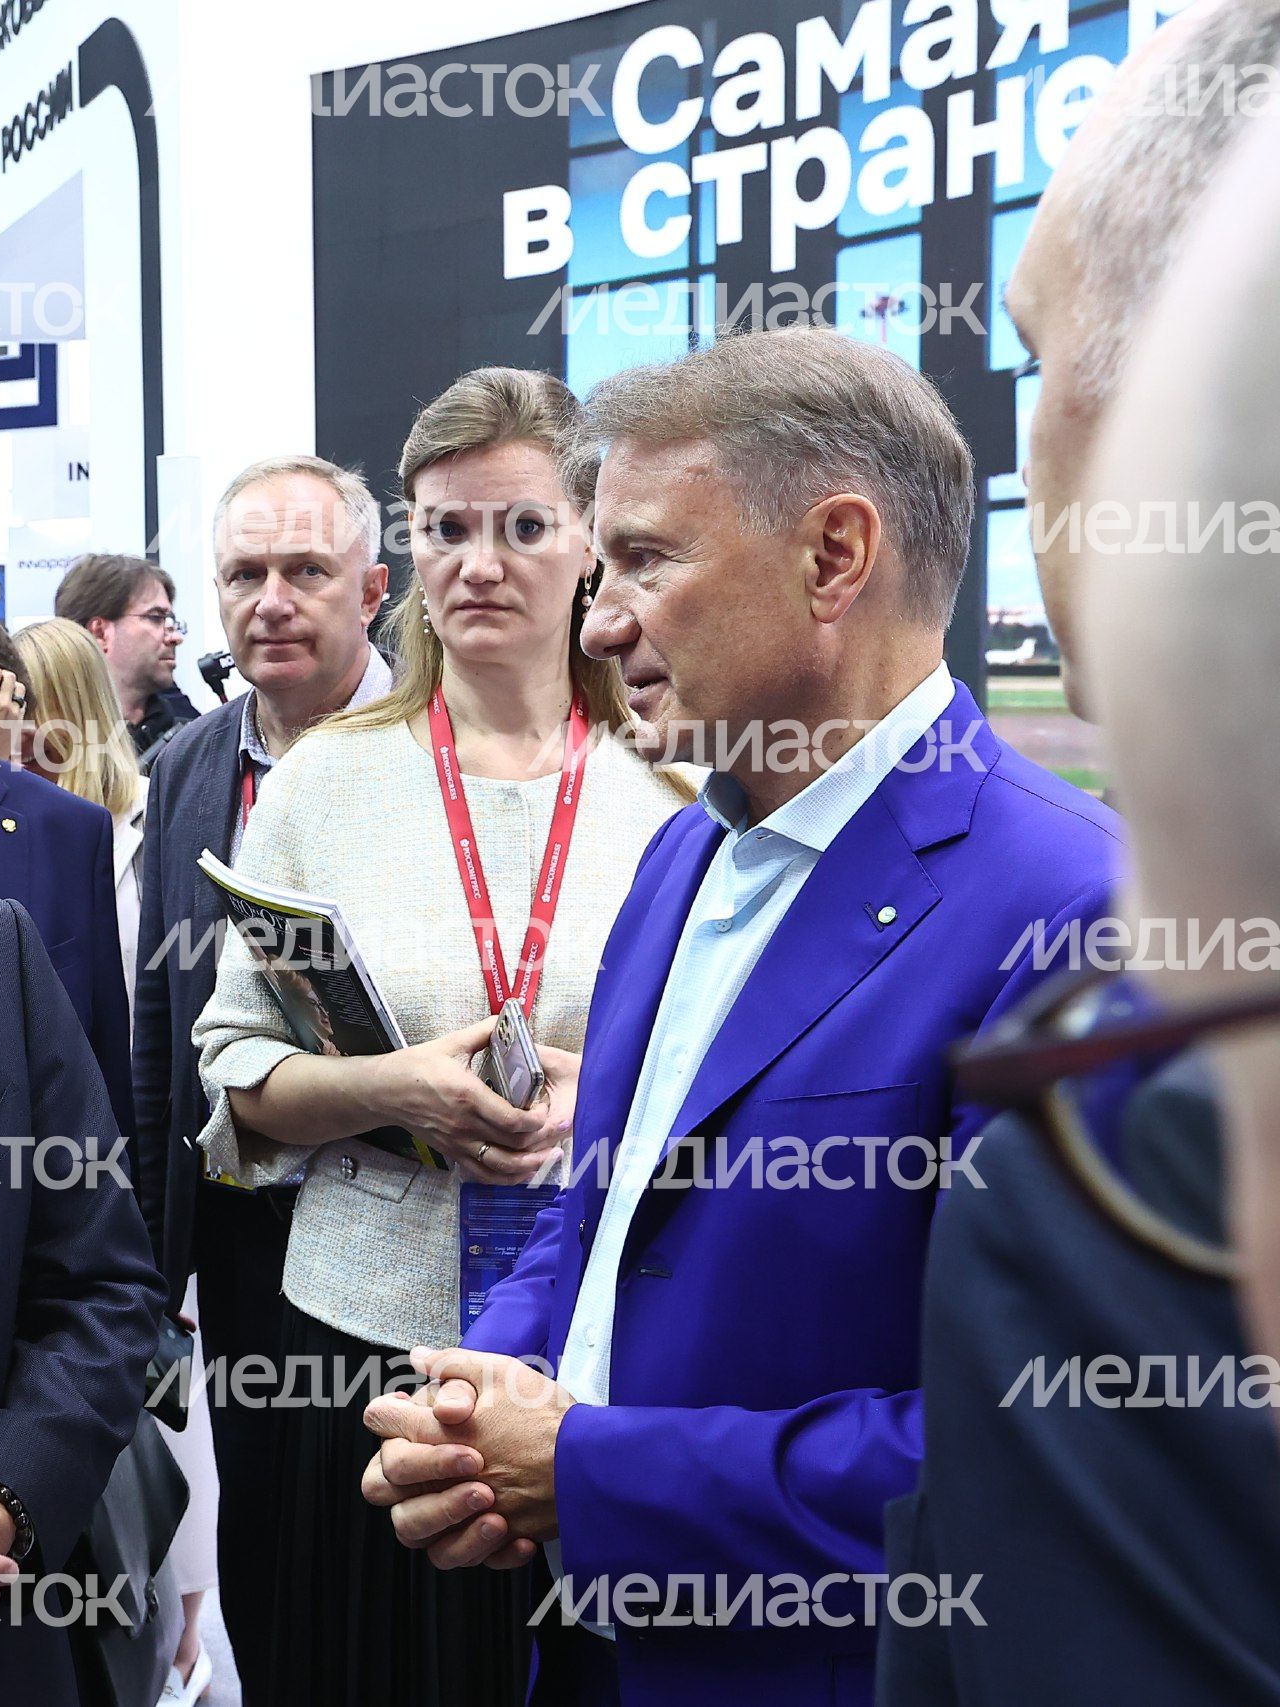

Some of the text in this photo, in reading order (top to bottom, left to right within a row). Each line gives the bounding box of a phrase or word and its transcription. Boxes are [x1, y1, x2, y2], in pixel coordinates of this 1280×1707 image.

[2, 60, 73, 174] РОССИИ
[612, 0, 1069, 154] Самая
[503, 53, 1120, 280] в стране
[463, 846, 482, 900] РОСКОНГРЕСС
[545, 843, 562, 895] ROSCONGRESS
